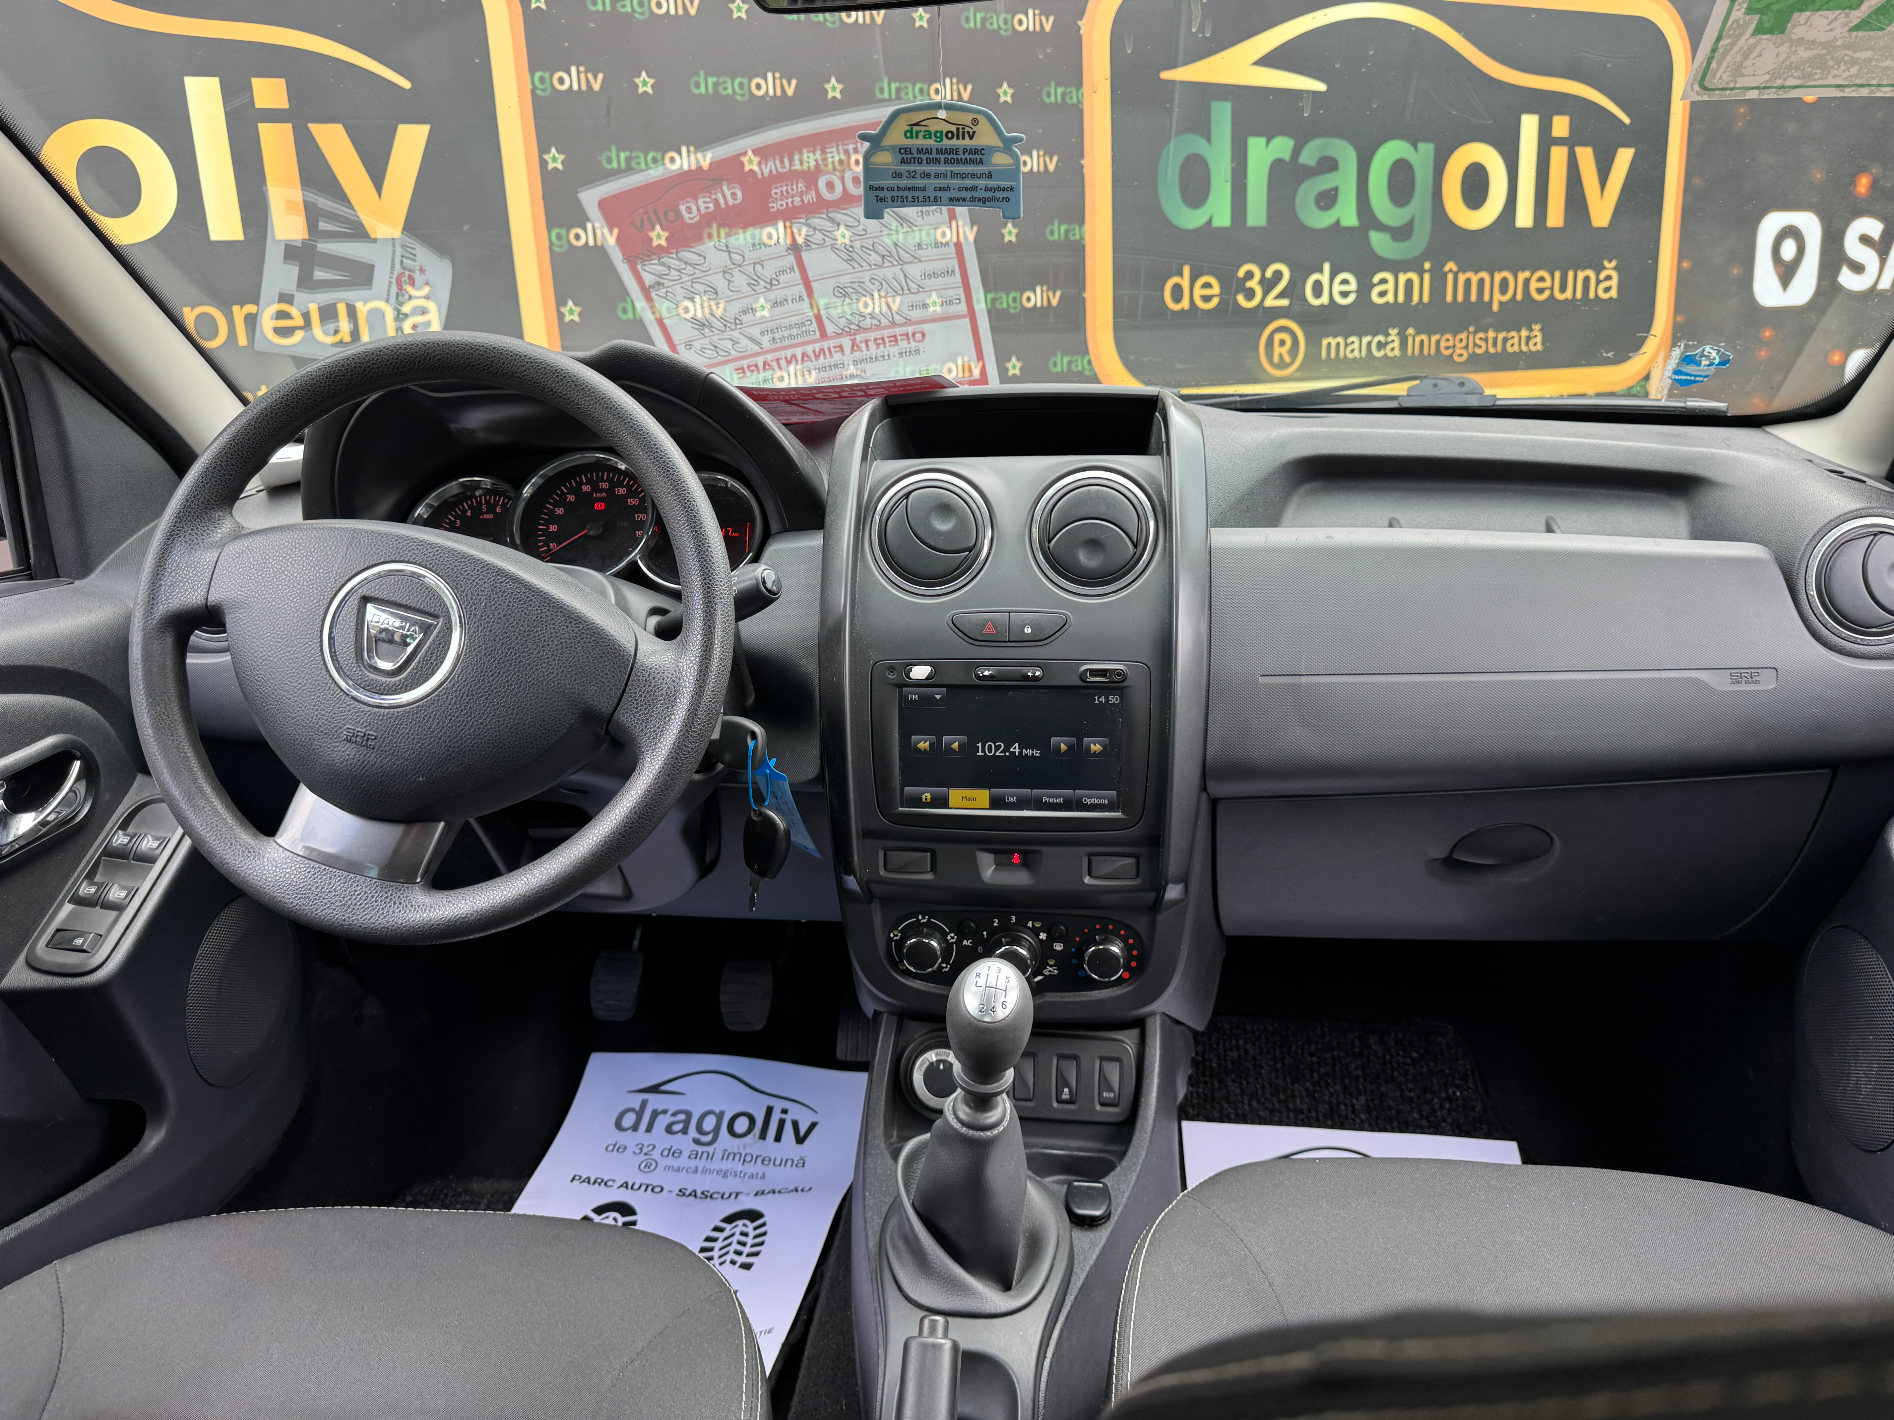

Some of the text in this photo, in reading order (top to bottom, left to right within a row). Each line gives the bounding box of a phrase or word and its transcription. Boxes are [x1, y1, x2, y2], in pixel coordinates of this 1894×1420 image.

[960, 8, 1055, 35] dragoliv
[530, 65, 604, 96] goliv
[689, 70, 798, 101] dragoliv
[875, 76, 973, 102] dragoliv
[904, 127, 976, 143] dragoliv
[898, 147, 986, 156] CEL MAI MARE PARC
[602, 145, 712, 175] dragoliv
[900, 157, 984, 165] AUTO DIN ROMANIA
[891, 170, 993, 182] de 32 de ani împreună
[1157, 101, 1635, 260] dragoliv
[983, 185, 1014, 193] bayback
[875, 195, 889, 203] Tel:
[948, 196, 1010, 204] www.dragoliv.ro
[1163, 259, 1618, 312] de 32 de ani împreună
[1321, 322, 1544, 363] marcă înregistrată
[615, 487, 627, 495] 130
[496, 505, 501, 513] 6
[627, 498, 639, 506] 150
[554, 507, 564, 515] 50
[370, 613, 419, 637] DACIA
[976, 742, 1041, 757] 102.4 MHz
[1042, 796, 1064, 804] Preset
[1082, 797, 1109, 806] Options
[1010, 915, 1016, 923] 3
[1001, 1001, 1007, 1009] 6
[614, 1098, 819, 1147] dragoliv
[605, 1141, 807, 1169] de 32 de ani împreună
[663, 1164, 767, 1181] marcă înregistrată
[569, 1173, 616, 1188] PARC
[617, 1179, 664, 1195] AUTO
[676, 1186, 743, 1201] SASCUT
